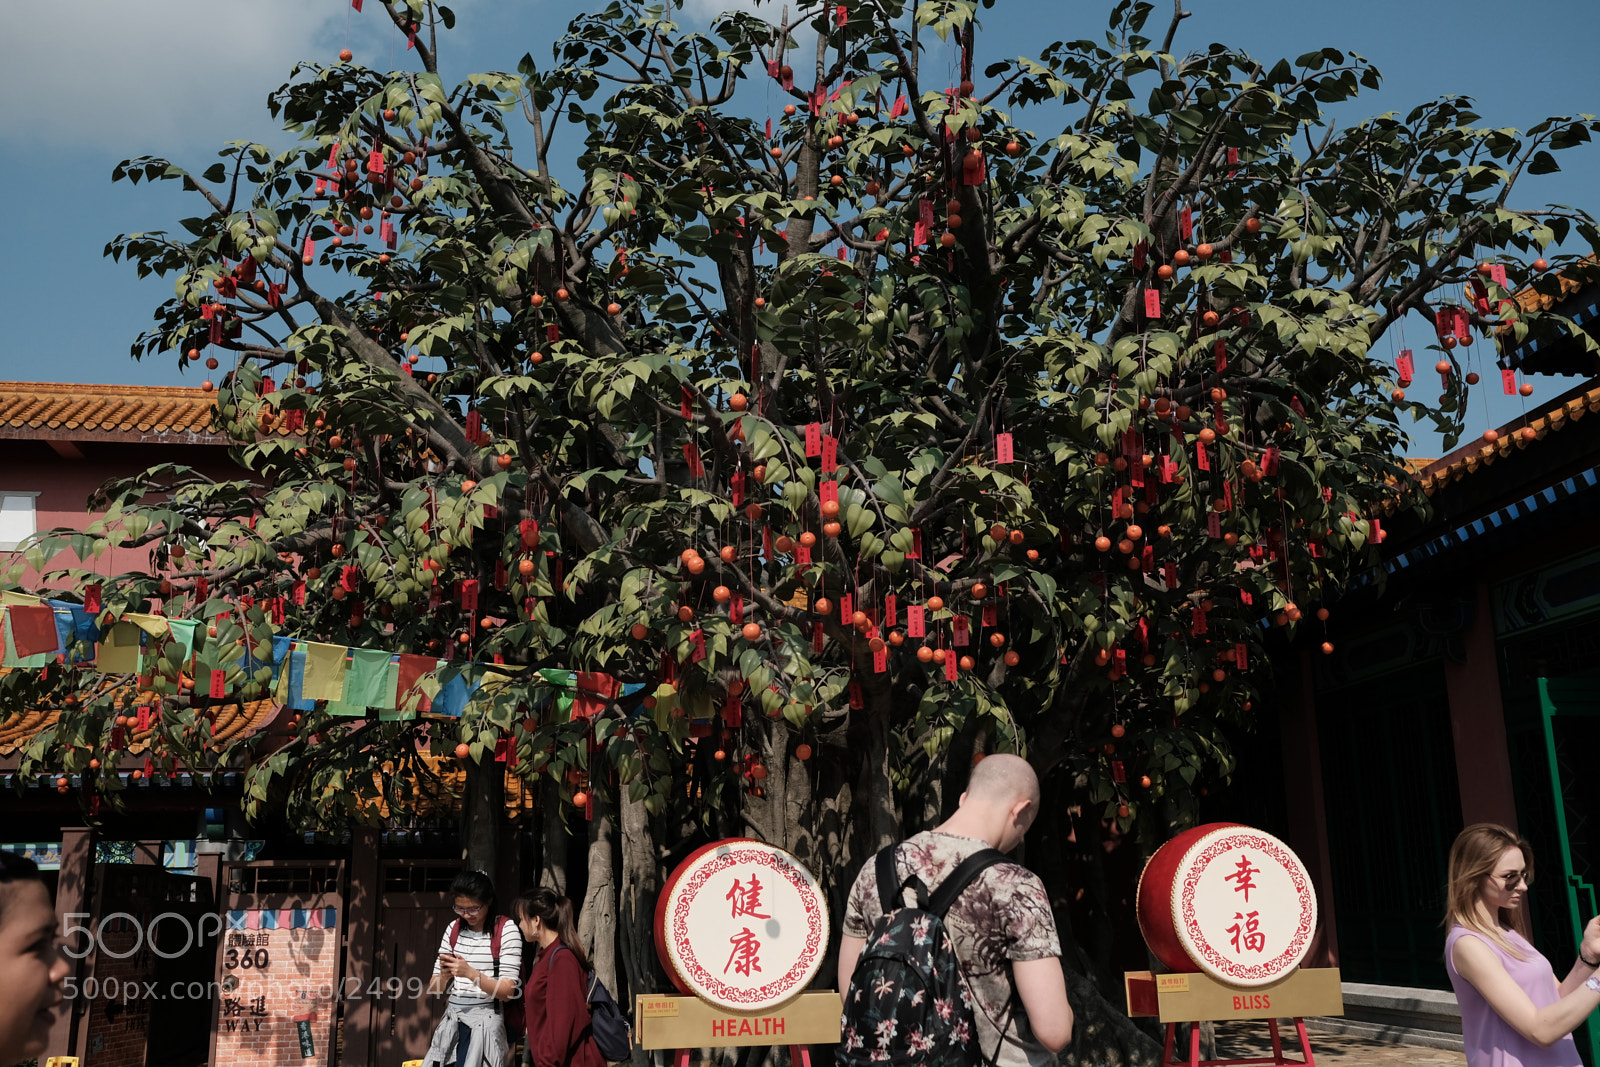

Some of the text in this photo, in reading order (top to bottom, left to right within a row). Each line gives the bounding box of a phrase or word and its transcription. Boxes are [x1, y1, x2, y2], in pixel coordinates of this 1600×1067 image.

[1224, 854, 1266, 954] 幸福
[723, 872, 772, 977] 健康
[225, 948, 269, 969] 360
[1233, 994, 1271, 1011] BLISS
[225, 1019, 264, 1033] WAY
[712, 1017, 786, 1037] HEALTH
